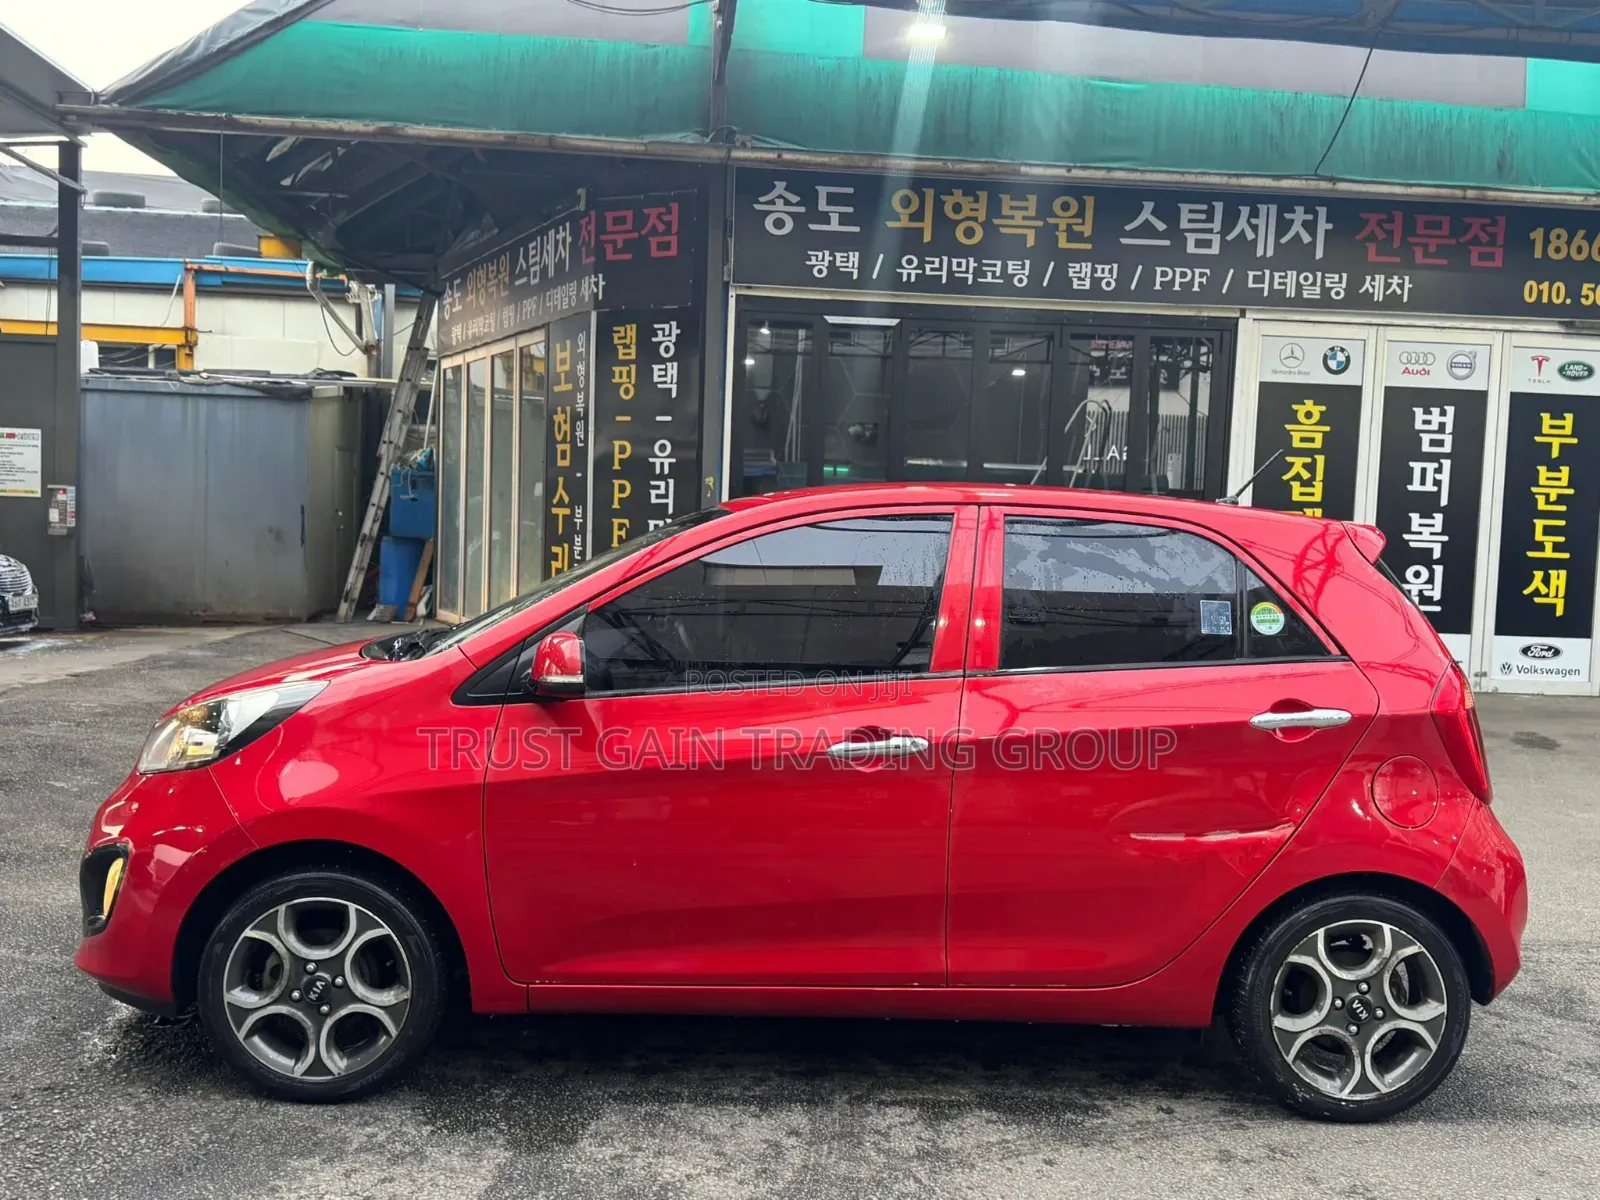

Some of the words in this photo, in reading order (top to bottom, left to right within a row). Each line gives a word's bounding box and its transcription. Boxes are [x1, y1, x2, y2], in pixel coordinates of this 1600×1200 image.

[442, 278, 462, 320] 송도
[466, 252, 510, 308] 외형복원
[514, 221, 572, 287] 스팀세차
[578, 202, 680, 265] 전문점
[753, 181, 860, 236] 송도
[885, 188, 1095, 250] 외형복원
[1119, 201, 1333, 260] 스팀세차
[1354, 210, 1507, 268] 전문점
[522, 295, 538, 320] PPF
[546, 279, 577, 314] 디테일링
[580, 272, 606, 303] 세차
[805, 250, 860, 280] 광택
[872, 253, 884, 280] /
[896, 254, 1031, 287] 유리막코팅
[1043, 261, 1054, 287] /
[1067, 262, 1118, 291] 랩핑
[1130, 265, 1143, 290] /
[1153, 267, 1211, 292] PPF
[1221, 268, 1234, 294] /
[1247, 269, 1348, 300] 디테일링
[1358, 274, 1413, 304] 세차
[1523, 279, 1572, 305] 010.
[575, 331, 586, 448] 외형복원
[612, 323, 637, 400] 랩핑
[651, 321, 681, 399] 광택
[1401, 366, 1430, 376] Audi
[551, 339, 574, 579] 보험수리
[1281, 399, 1331, 518] 흠집
[573, 505, 583, 566] 부분
[1402, 405, 1455, 612] 범퍼복원
[1522, 412, 1579, 617] 부분도색
[1516, 664, 1581, 678] Volkswagen
[1527, 644, 1555, 658] Ford
[308, 980, 326, 1001] KIA
